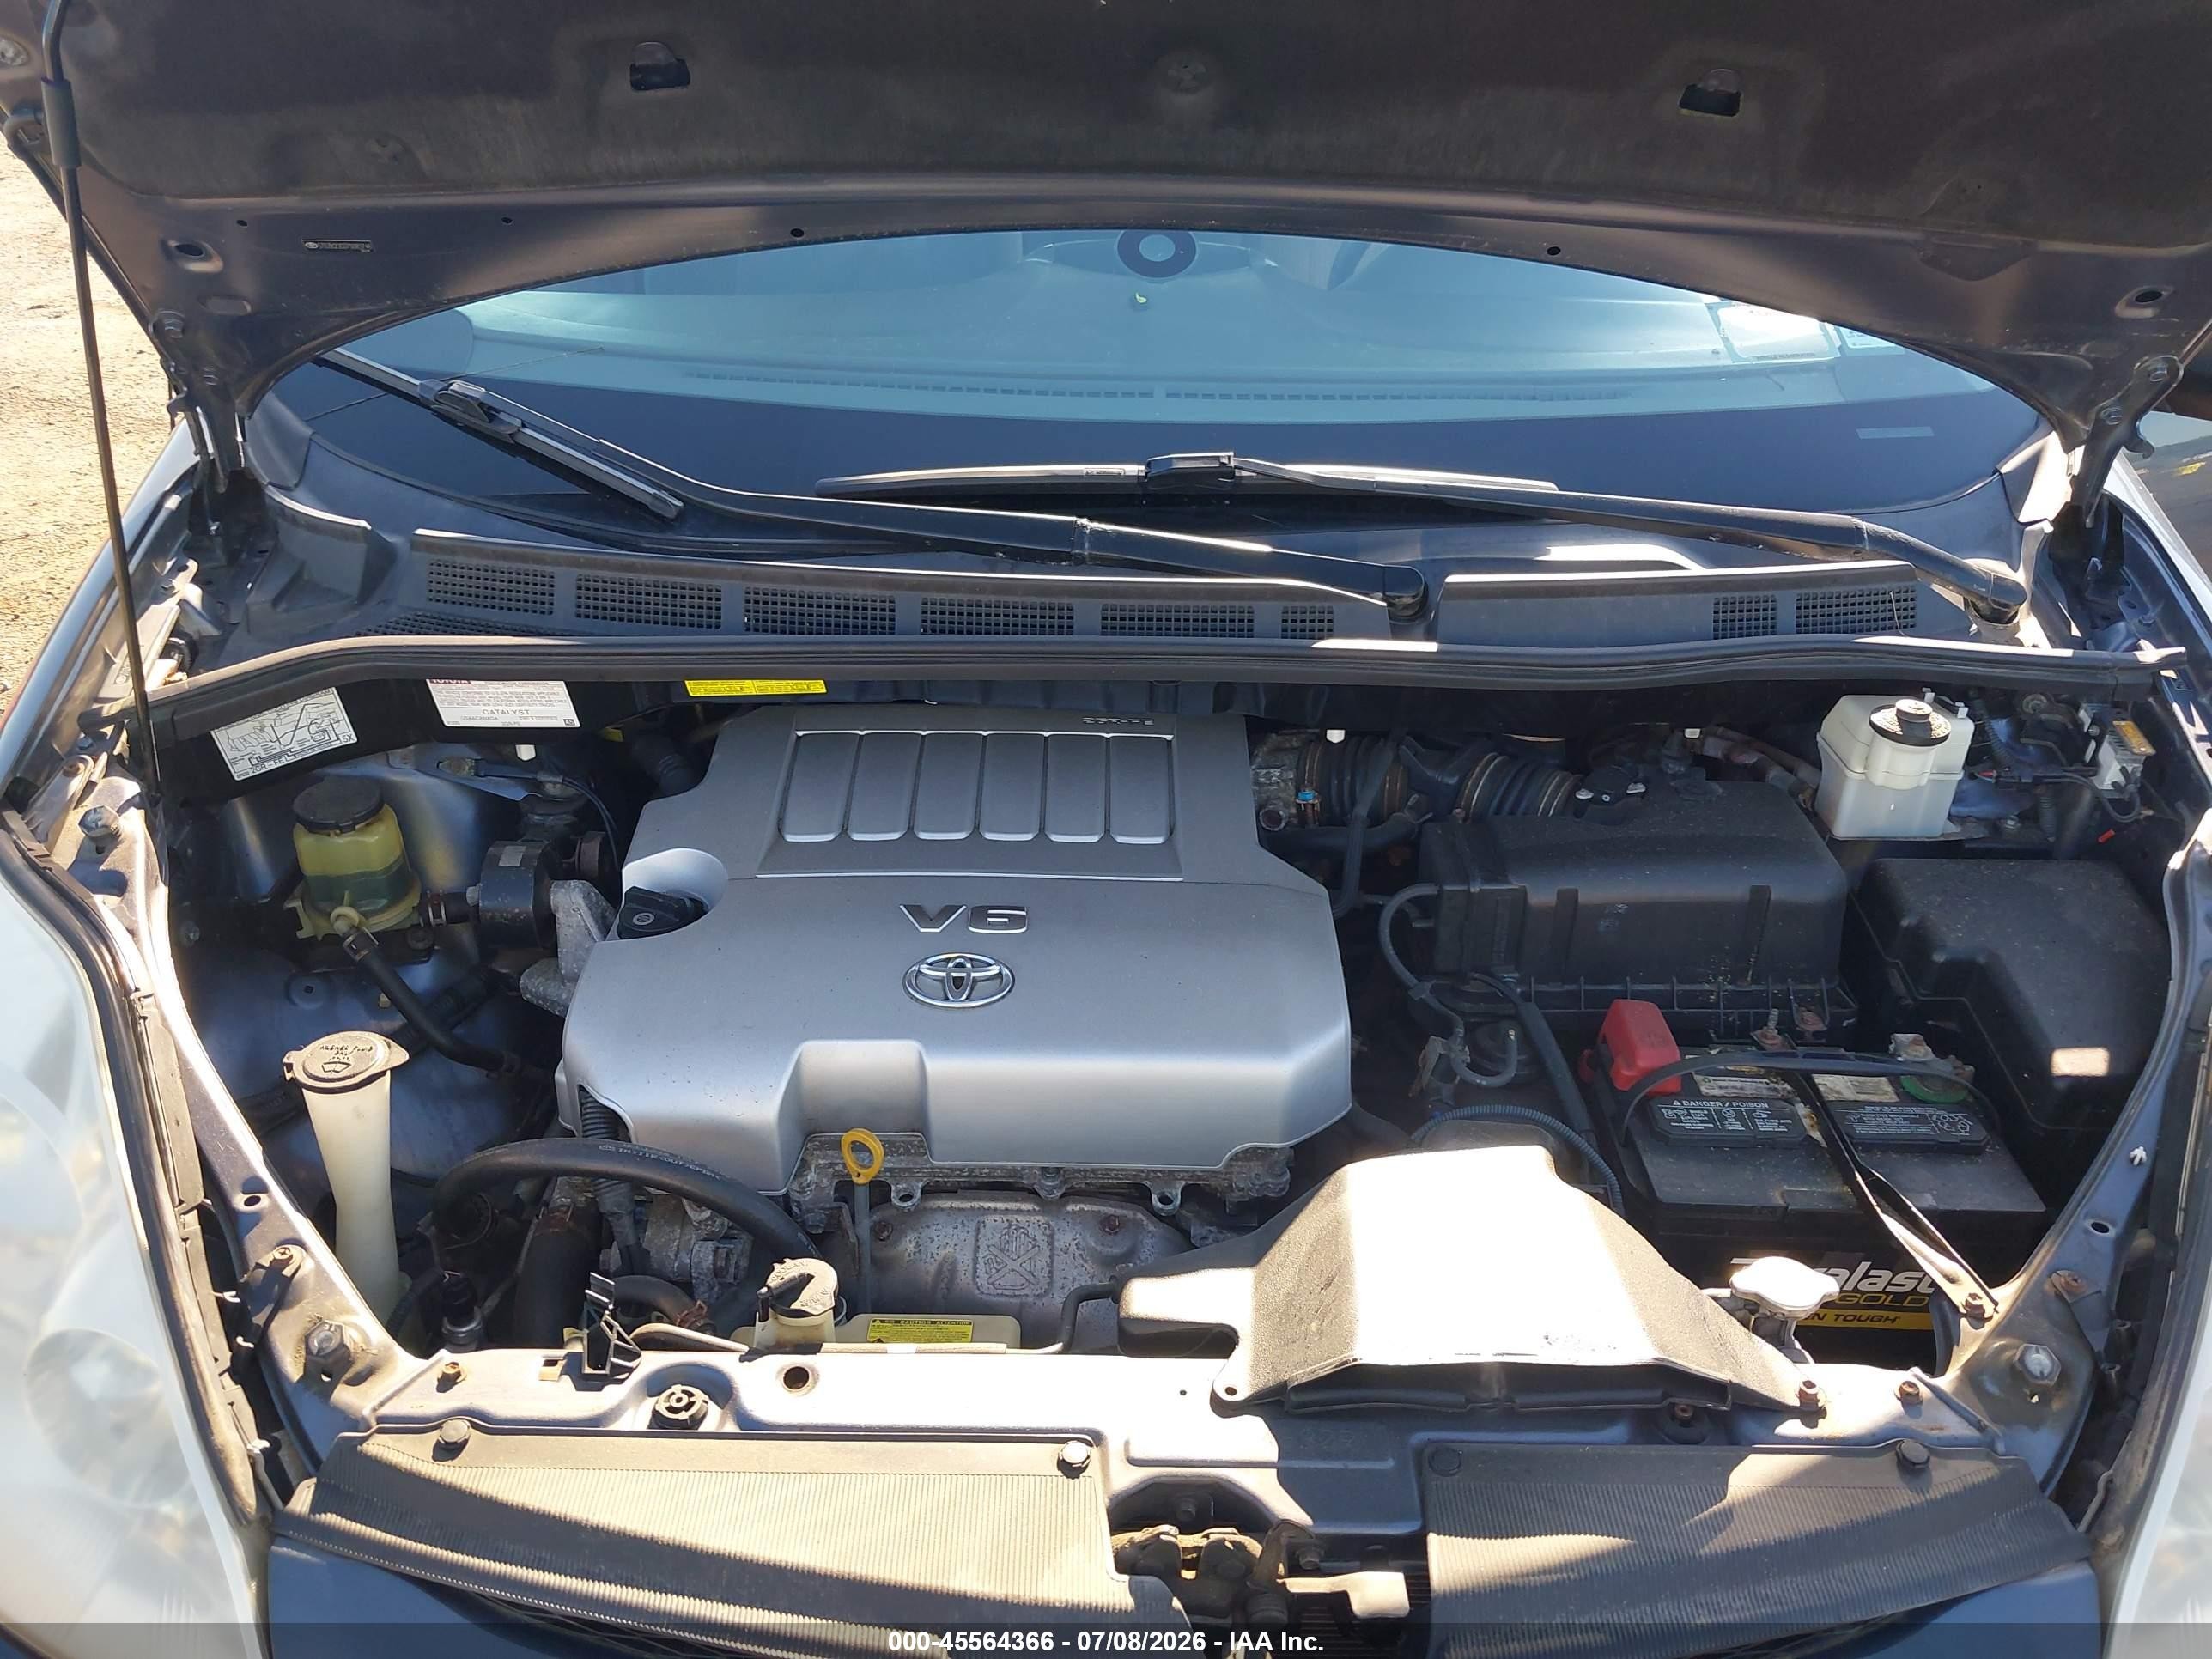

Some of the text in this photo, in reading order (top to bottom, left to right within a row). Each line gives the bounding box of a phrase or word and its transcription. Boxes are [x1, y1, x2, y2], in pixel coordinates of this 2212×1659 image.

[343, 733, 356, 744] 5X
[900, 904, 1029, 934] V6
[1834, 1292, 1929, 1308] GOLD
[1833, 1313, 1898, 1324] TOUGH
